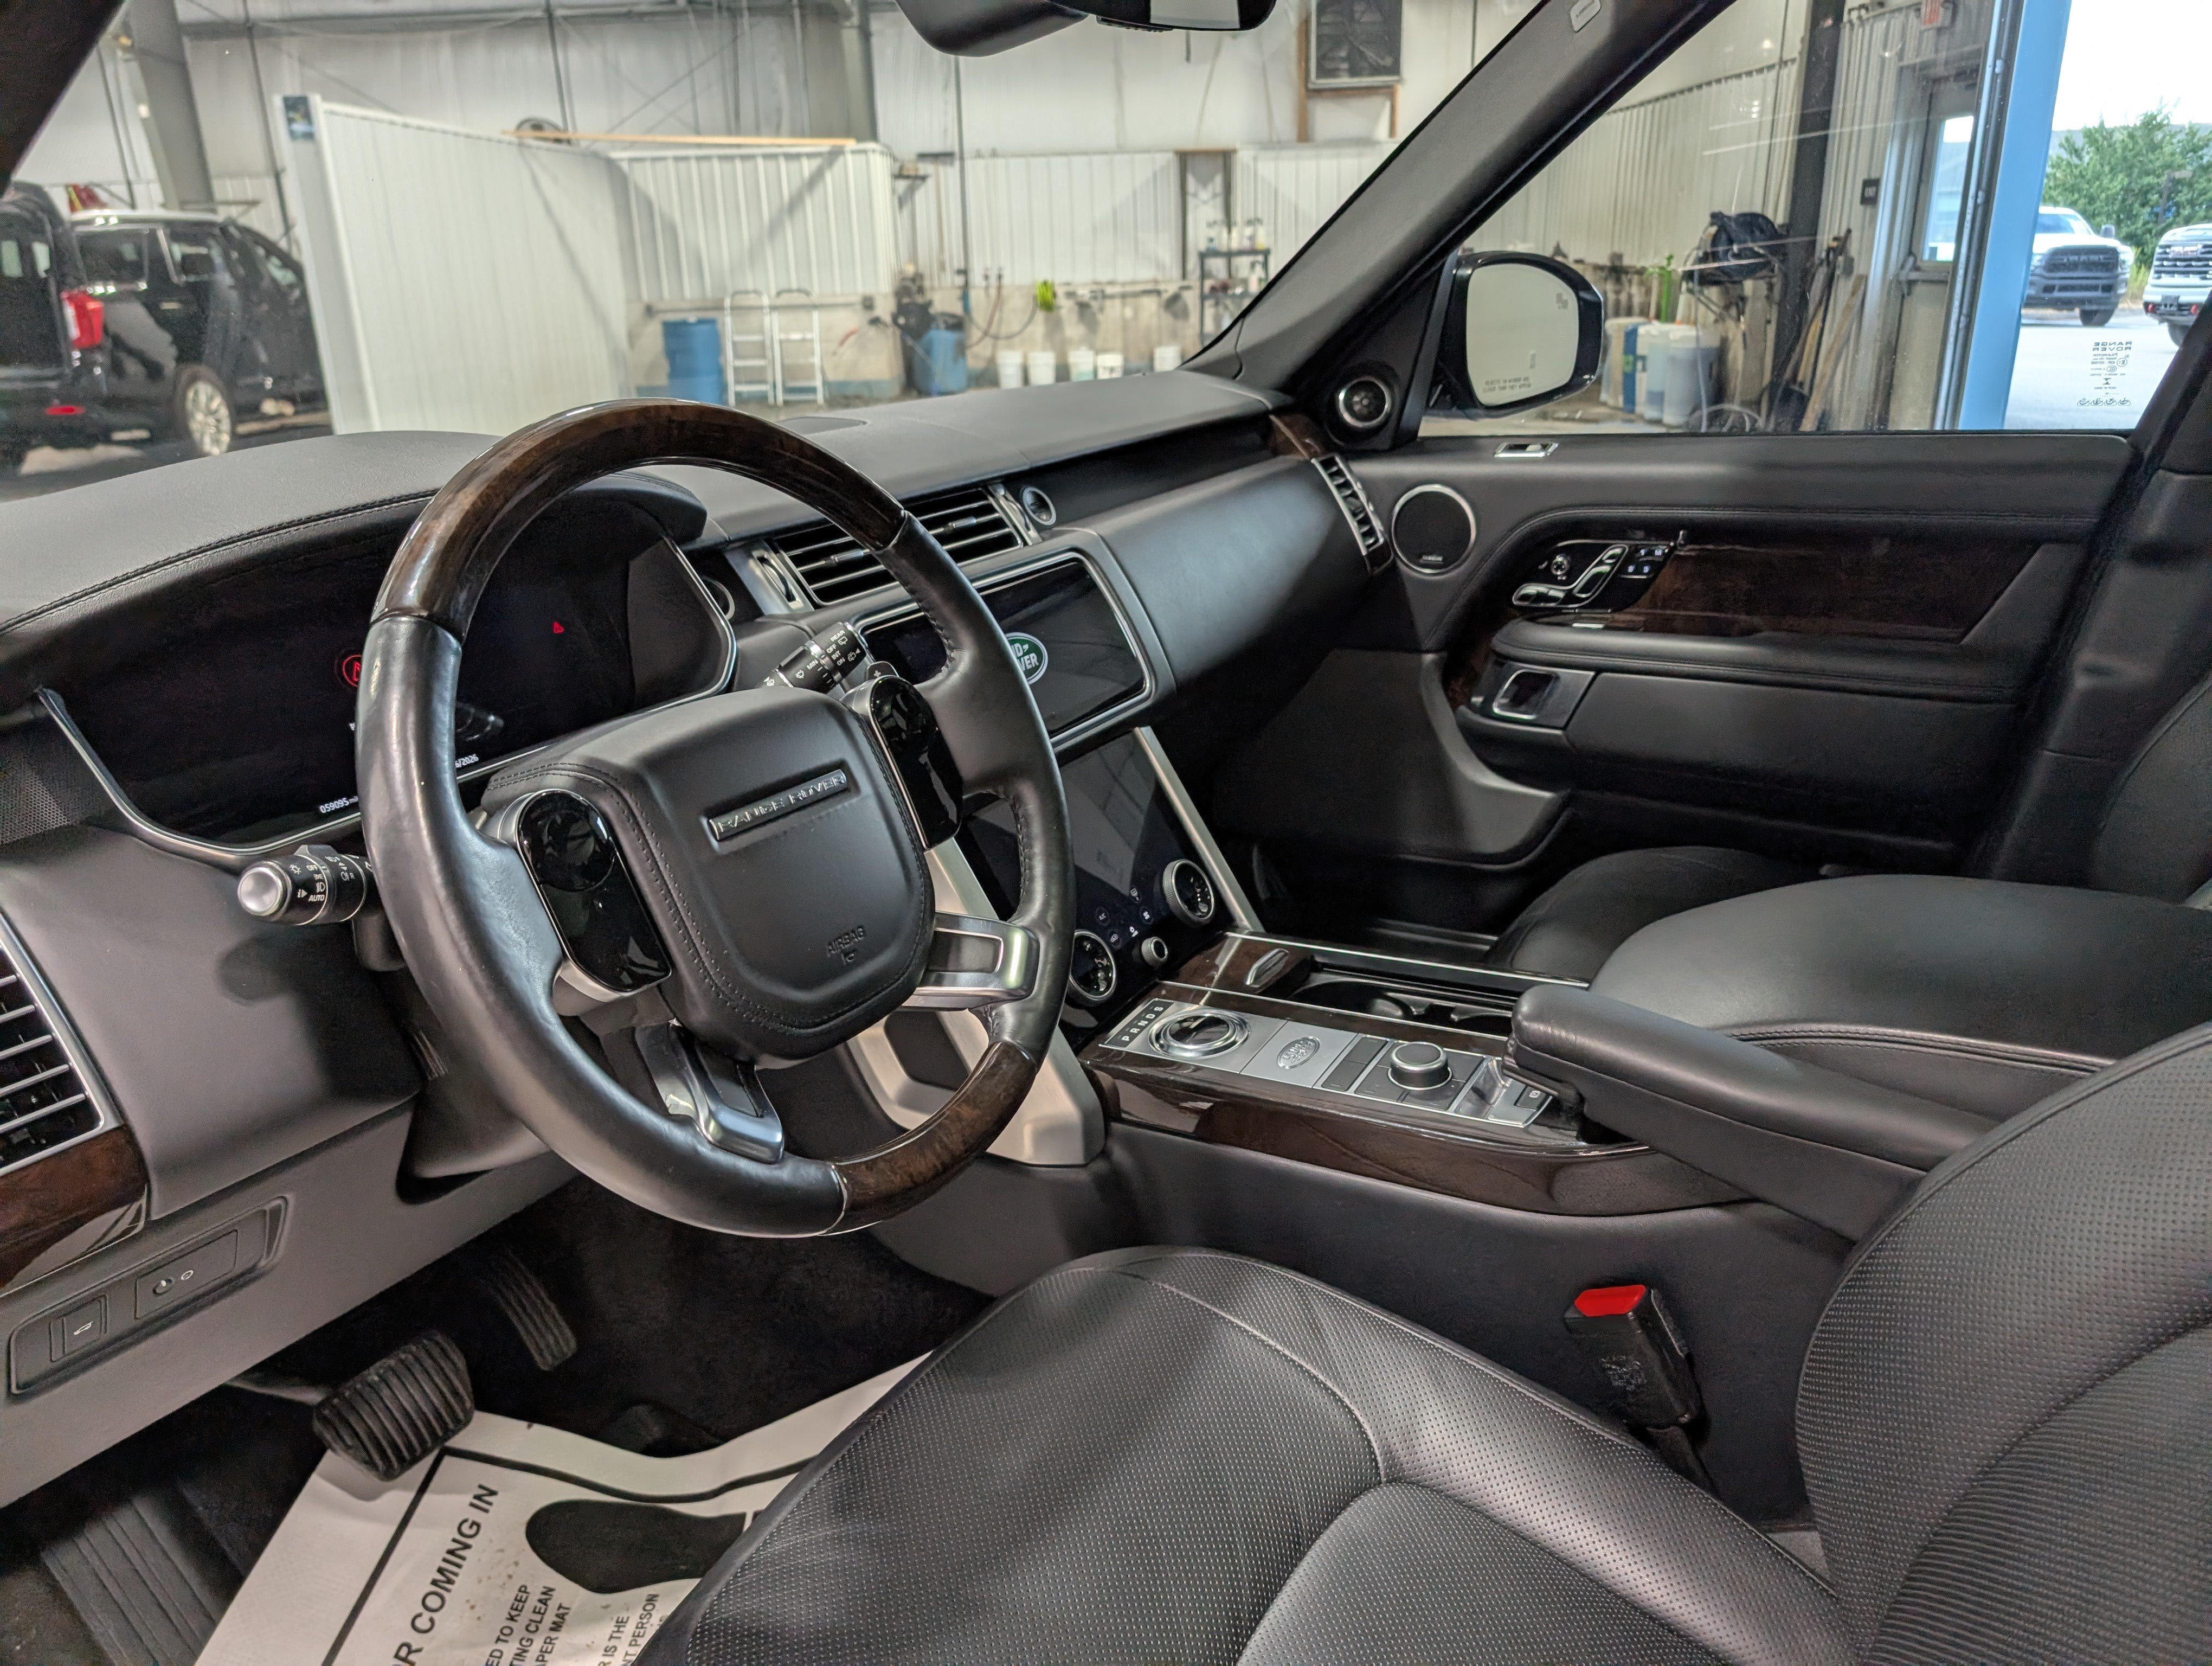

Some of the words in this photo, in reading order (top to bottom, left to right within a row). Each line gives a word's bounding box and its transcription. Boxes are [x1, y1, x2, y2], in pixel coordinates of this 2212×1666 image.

[830, 630, 845, 642] REAR
[826, 643, 837, 653] OFF
[831, 650, 841, 660] INT
[806, 659, 819, 670] MIN
[837, 658, 846, 667] ON
[1018, 652, 1039, 671] VER
[319, 797, 349, 813] 059095
[718, 798, 785, 832] RANGE
[788, 774, 845, 804] ROVER
[826, 925, 866, 958] AIRBAG
[393, 1642, 425, 1666] R
[411, 1518, 482, 1634] COMING
[469, 1484, 498, 1513] IN
[494, 1625, 514, 1644] TO
[505, 1584, 530, 1623] KEEP
[525, 1586, 556, 1634] CLEAN
[628, 1593, 660, 1646] PERSON
[533, 1636, 558, 1666] PER
[549, 1603, 570, 1632] MAT
[608, 1616, 630, 1642] THE
[602, 1645, 618, 1657] IS
